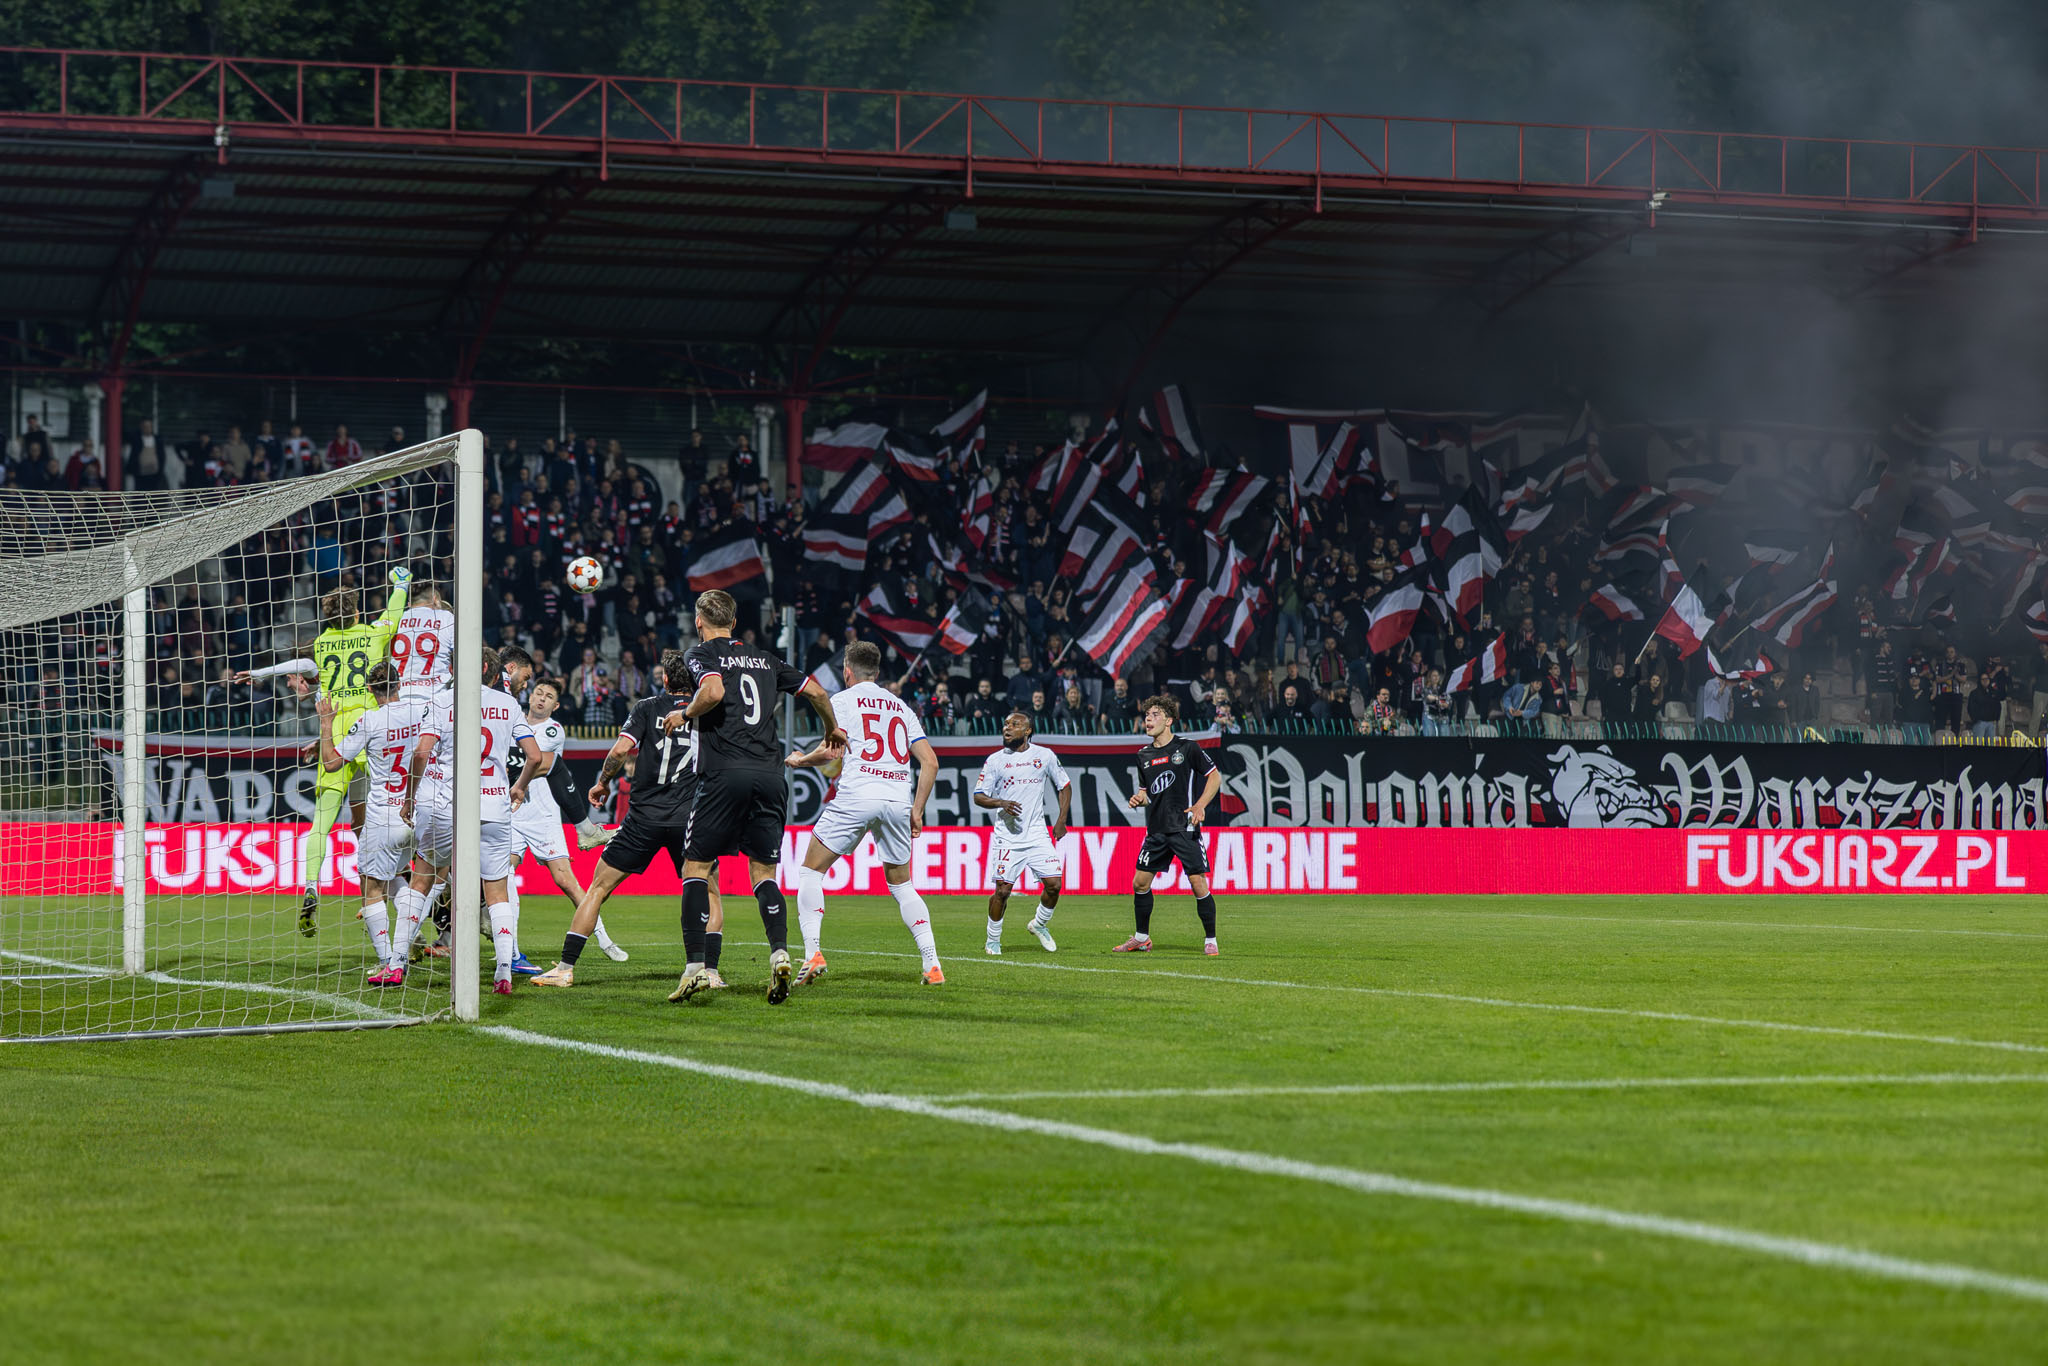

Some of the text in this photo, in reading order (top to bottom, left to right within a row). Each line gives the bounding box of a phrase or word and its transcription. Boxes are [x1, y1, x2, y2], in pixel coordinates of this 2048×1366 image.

[323, 651, 370, 690] 28
[390, 632, 440, 677] 99
[739, 673, 761, 726] 9
[857, 697, 904, 714] KUTWA
[387, 722, 421, 742] GIGE
[860, 713, 910, 765] 50
[382, 745, 409, 793] 3
[655, 736, 693, 785] 17
[860, 765, 908, 781] SUPERBET
[1226, 743, 1533, 828] Polonia
[999, 848, 1011, 862] 12
[1138, 849, 1150, 867] 44
[1687, 834, 2026, 888] FUKSIARZ.PL
